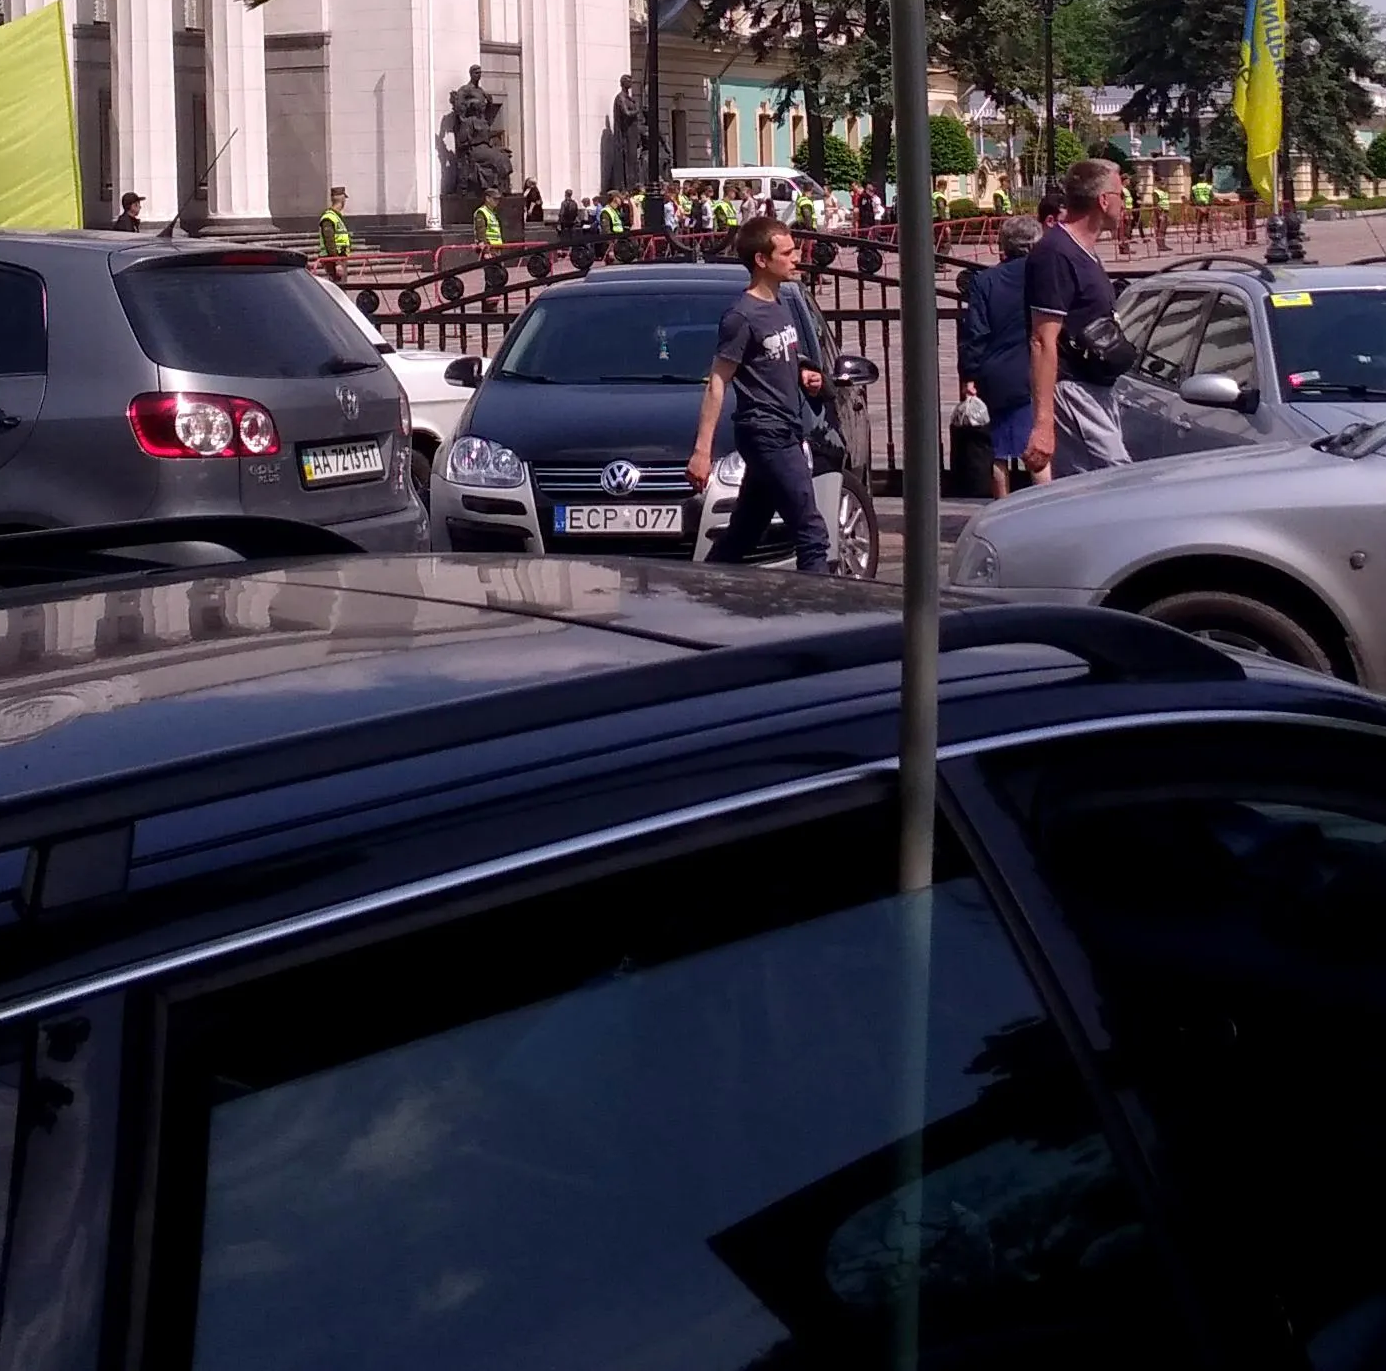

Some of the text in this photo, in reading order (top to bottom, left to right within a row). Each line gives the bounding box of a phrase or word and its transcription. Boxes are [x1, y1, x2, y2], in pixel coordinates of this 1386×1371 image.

[313, 450, 333, 476] AA
[569, 508, 618, 529] ECP
[635, 508, 678, 529] 077
